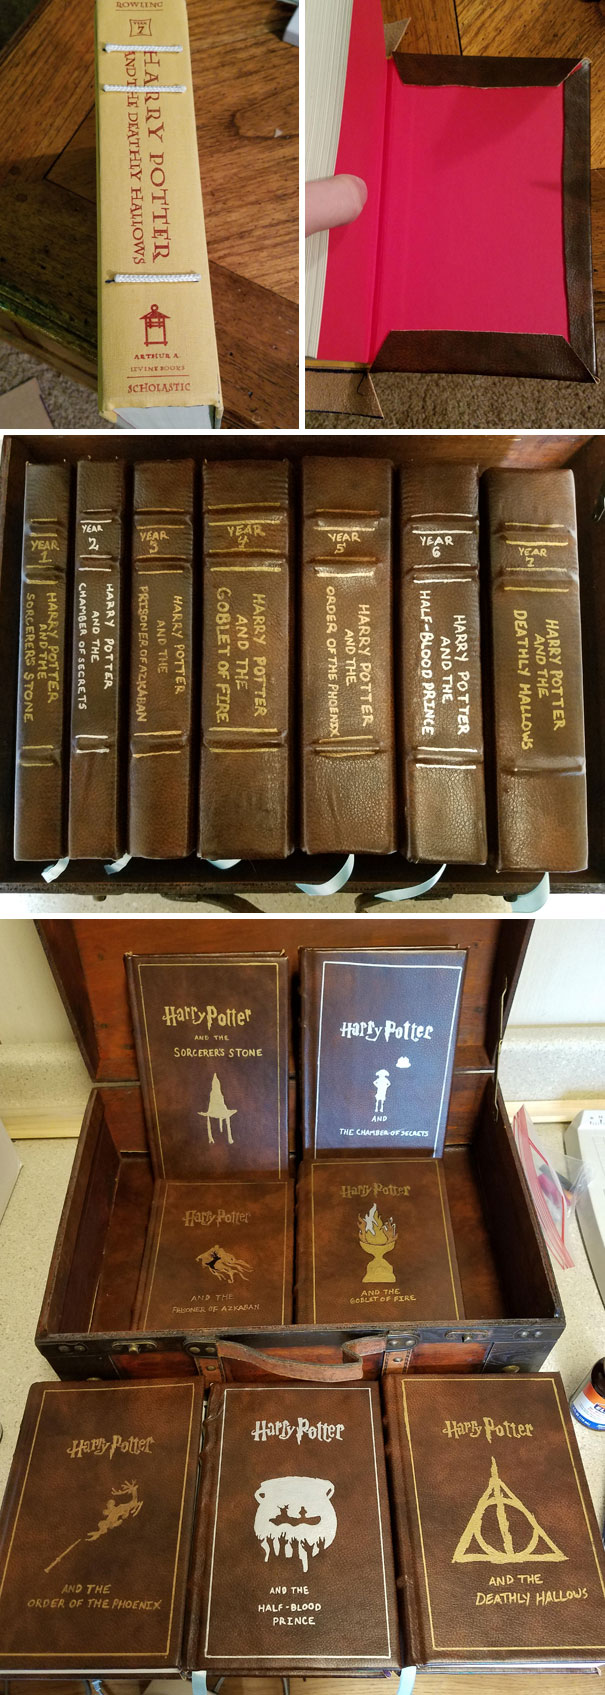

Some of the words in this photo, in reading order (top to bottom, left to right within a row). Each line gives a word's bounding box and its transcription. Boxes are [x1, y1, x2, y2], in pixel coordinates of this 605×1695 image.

[138, 25, 145, 35] 7
[144, 51, 164, 143] HARRY
[127, 112, 143, 182] DEATHLY
[150, 152, 171, 263] POTTER
[130, 187, 146, 264] HALLOWS
[128, 382, 191, 393] SCHOLASTIC
[81, 524, 103, 533] YEAR
[140, 530, 169, 542] YEAR
[227, 525, 265, 537] YEAR
[328, 532, 361, 542] YEAR
[420, 536, 454, 546] YEAR
[30, 540, 60, 551] YEAR
[88, 538, 99, 551] 2
[149, 541, 159, 554] 3
[237, 537, 249, 550] 4
[334, 543, 347, 554] 5
[432, 547, 441, 558] 6
[518, 547, 547, 557] YEAR
[39, 551, 52, 563] 1
[525, 556, 535, 568] 7
[46, 592, 58, 639] HARRY
[78, 582, 87, 636] CHAMBER
[104, 583, 115, 627] HARRY
[171, 595, 183, 639] HARRY
[326, 586, 337, 634] ORDER
[91, 610, 101, 635] AND
[216, 587, 232, 656] GOBLET
[235, 614, 249, 650] AND
[252, 593, 266, 645] HARRY
[358, 604, 371, 656] HARRY
[39, 623, 48, 650] AND
[156, 620, 167, 645] AND
[344, 629, 356, 655] AND
[419, 590, 434, 679] HALF-BLOOD
[453, 615, 469, 662] HARRY
[513, 609, 531, 677] DEATHLY
[545, 619, 561, 665] HARRY
[78, 641, 86, 656] OF
[90, 638, 100, 664] THE
[139, 649, 148, 664] OF
[326, 638, 337, 657] OF
[440, 636, 452, 671] AND
[533, 633, 546, 666] AND
[37, 652, 48, 680] THE
[103, 638, 115, 690] POTTER
[157, 648, 168, 674] THE
[173, 644, 186, 695] POTTER
[217, 660, 230, 680] OF
[234, 657, 249, 690] THE
[327, 657, 338, 681] THE
[344, 657, 357, 687] THE
[48, 645, 59, 704] POTTER
[77, 657, 87, 710] SECRETS
[253, 656, 267, 717] POTTER
[536, 669, 549, 699] THE
[23, 671, 35, 723] STONE
[136, 665, 148, 722] AZKABAN
[359, 662, 374, 727] POTTER
[442, 674, 453, 704] THE
[550, 669, 566, 731] POTTER
[216, 683, 230, 723] FIRE
[422, 682, 436, 736] PRINCE
[456, 671, 470, 735] POTTER
[518, 683, 534, 750] HALLOWS
[162, 1006, 206, 1026] Harry
[206, 1005, 252, 1031] Potter
[340, 1020, 383, 1041] Harry
[384, 1020, 434, 1042] Potter
[174, 1047, 225, 1058] SORCERER'S
[228, 1048, 263, 1058] STONE
[339, 1128, 355, 1136] THE
[356, 1128, 389, 1136] CHAMBER
[371, 1115, 388, 1123] AND
[340, 1185, 372, 1198] Harry
[373, 1182, 411, 1197] Potter
[183, 1210, 217, 1227] Harry
[217, 1209, 251, 1227] Potter
[191, 1294, 211, 1302] AND
[215, 1293, 235, 1302] THE
[350, 1296, 379, 1304] GOBLET
[393, 1294, 416, 1302] FIRE
[361, 1289, 380, 1297] AND
[208, 1305, 219, 1313] OF
[221, 1303, 260, 1312] AZKABAN
[251, 1420, 296, 1441] Harry
[296, 1417, 345, 1445] Potter
[442, 1420, 482, 1439] Harry
[482, 1417, 534, 1443] Potter
[66, 1437, 110, 1459] Harry
[109, 1434, 155, 1460] Potter
[61, 1583, 83, 1594] AND
[86, 1583, 112, 1594] THE
[269, 1586, 287, 1595] AND
[291, 1586, 310, 1595] THE
[489, 1574, 514, 1586] AND
[517, 1574, 544, 1584] THE
[27, 1599, 65, 1609] ORDER
[68, 1599, 84, 1609] OF
[87, 1599, 110, 1608] THE
[111, 1598, 162, 1610] PHOENIX
[475, 1591, 531, 1606] DEATHLY
[536, 1588, 588, 1606] HALLOWS
[272, 1616, 316, 1626] PRINCE
